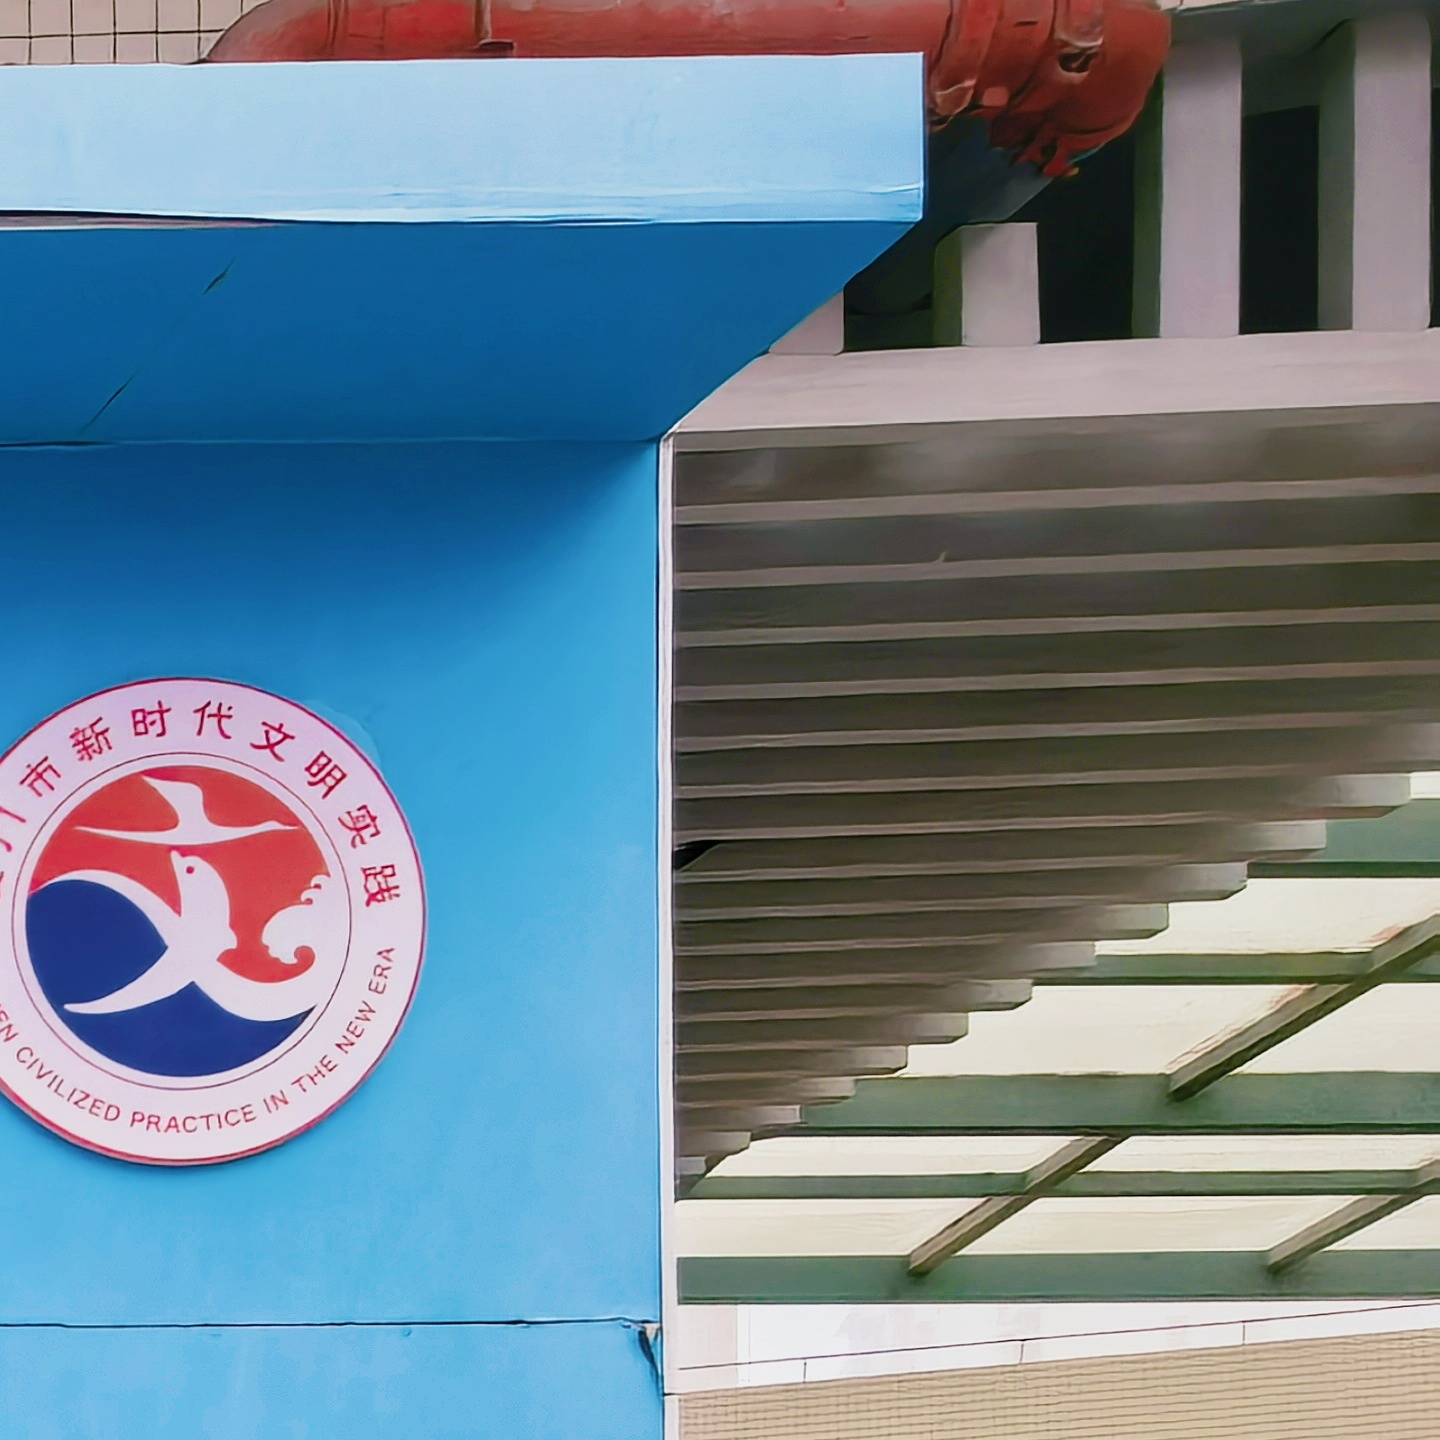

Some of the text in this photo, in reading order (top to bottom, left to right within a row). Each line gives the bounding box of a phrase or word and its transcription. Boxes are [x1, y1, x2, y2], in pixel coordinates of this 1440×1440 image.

[16, 1046, 121, 1122] CIVILIZED
[129, 1103, 258, 1134] PRACTICE
[262, 1089, 290, 1114] IN
[290, 1054, 339, 1093] THE
[334, 1000, 377, 1055] NEW
[367, 947, 396, 995] ERA
